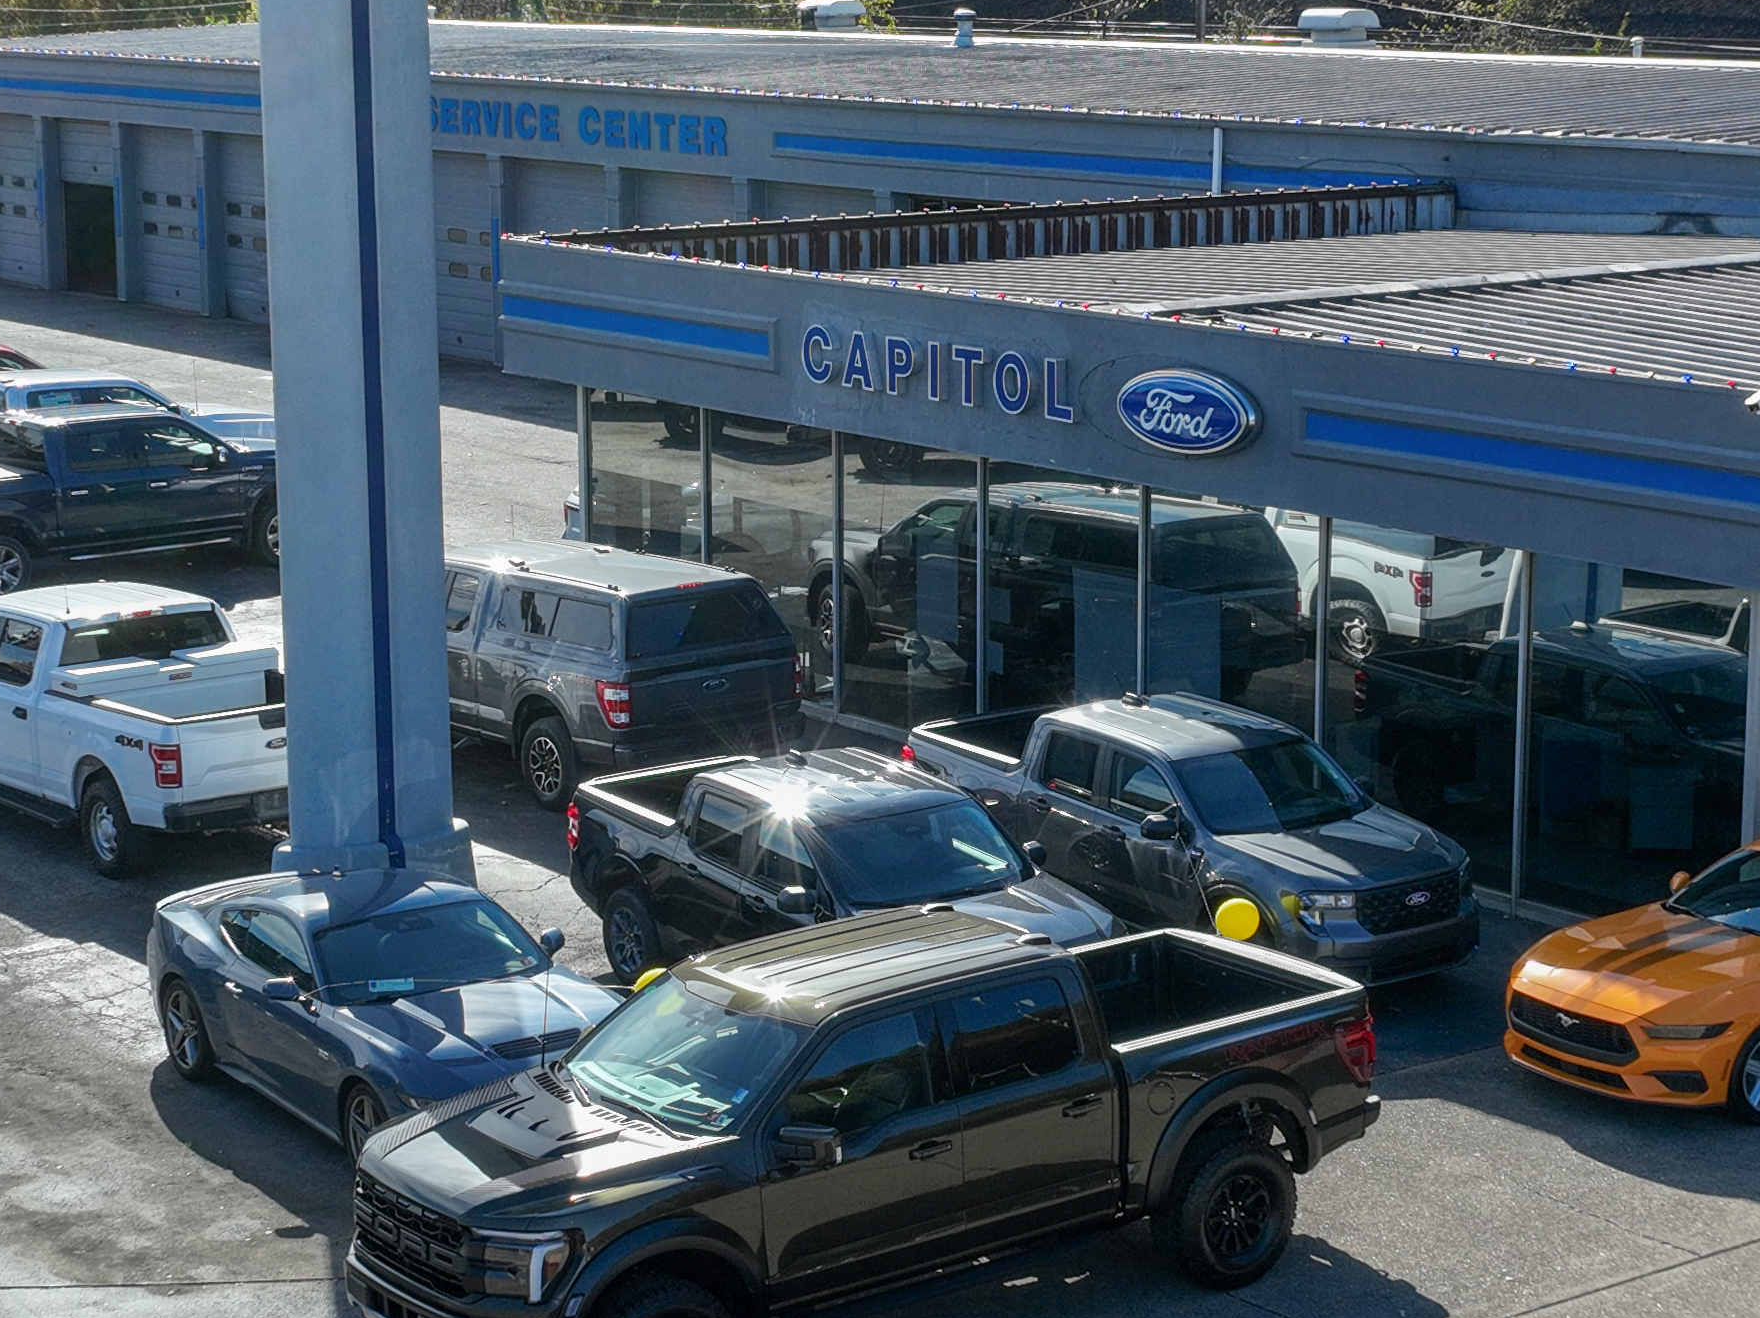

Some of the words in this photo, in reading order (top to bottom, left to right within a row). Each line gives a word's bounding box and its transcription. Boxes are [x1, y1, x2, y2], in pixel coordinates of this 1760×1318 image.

[577, 106, 728, 156] CENTER
[801, 324, 1074, 424] CAPITOL
[1139, 387, 1215, 440] Ford
[115, 734, 144, 751] 4X4
